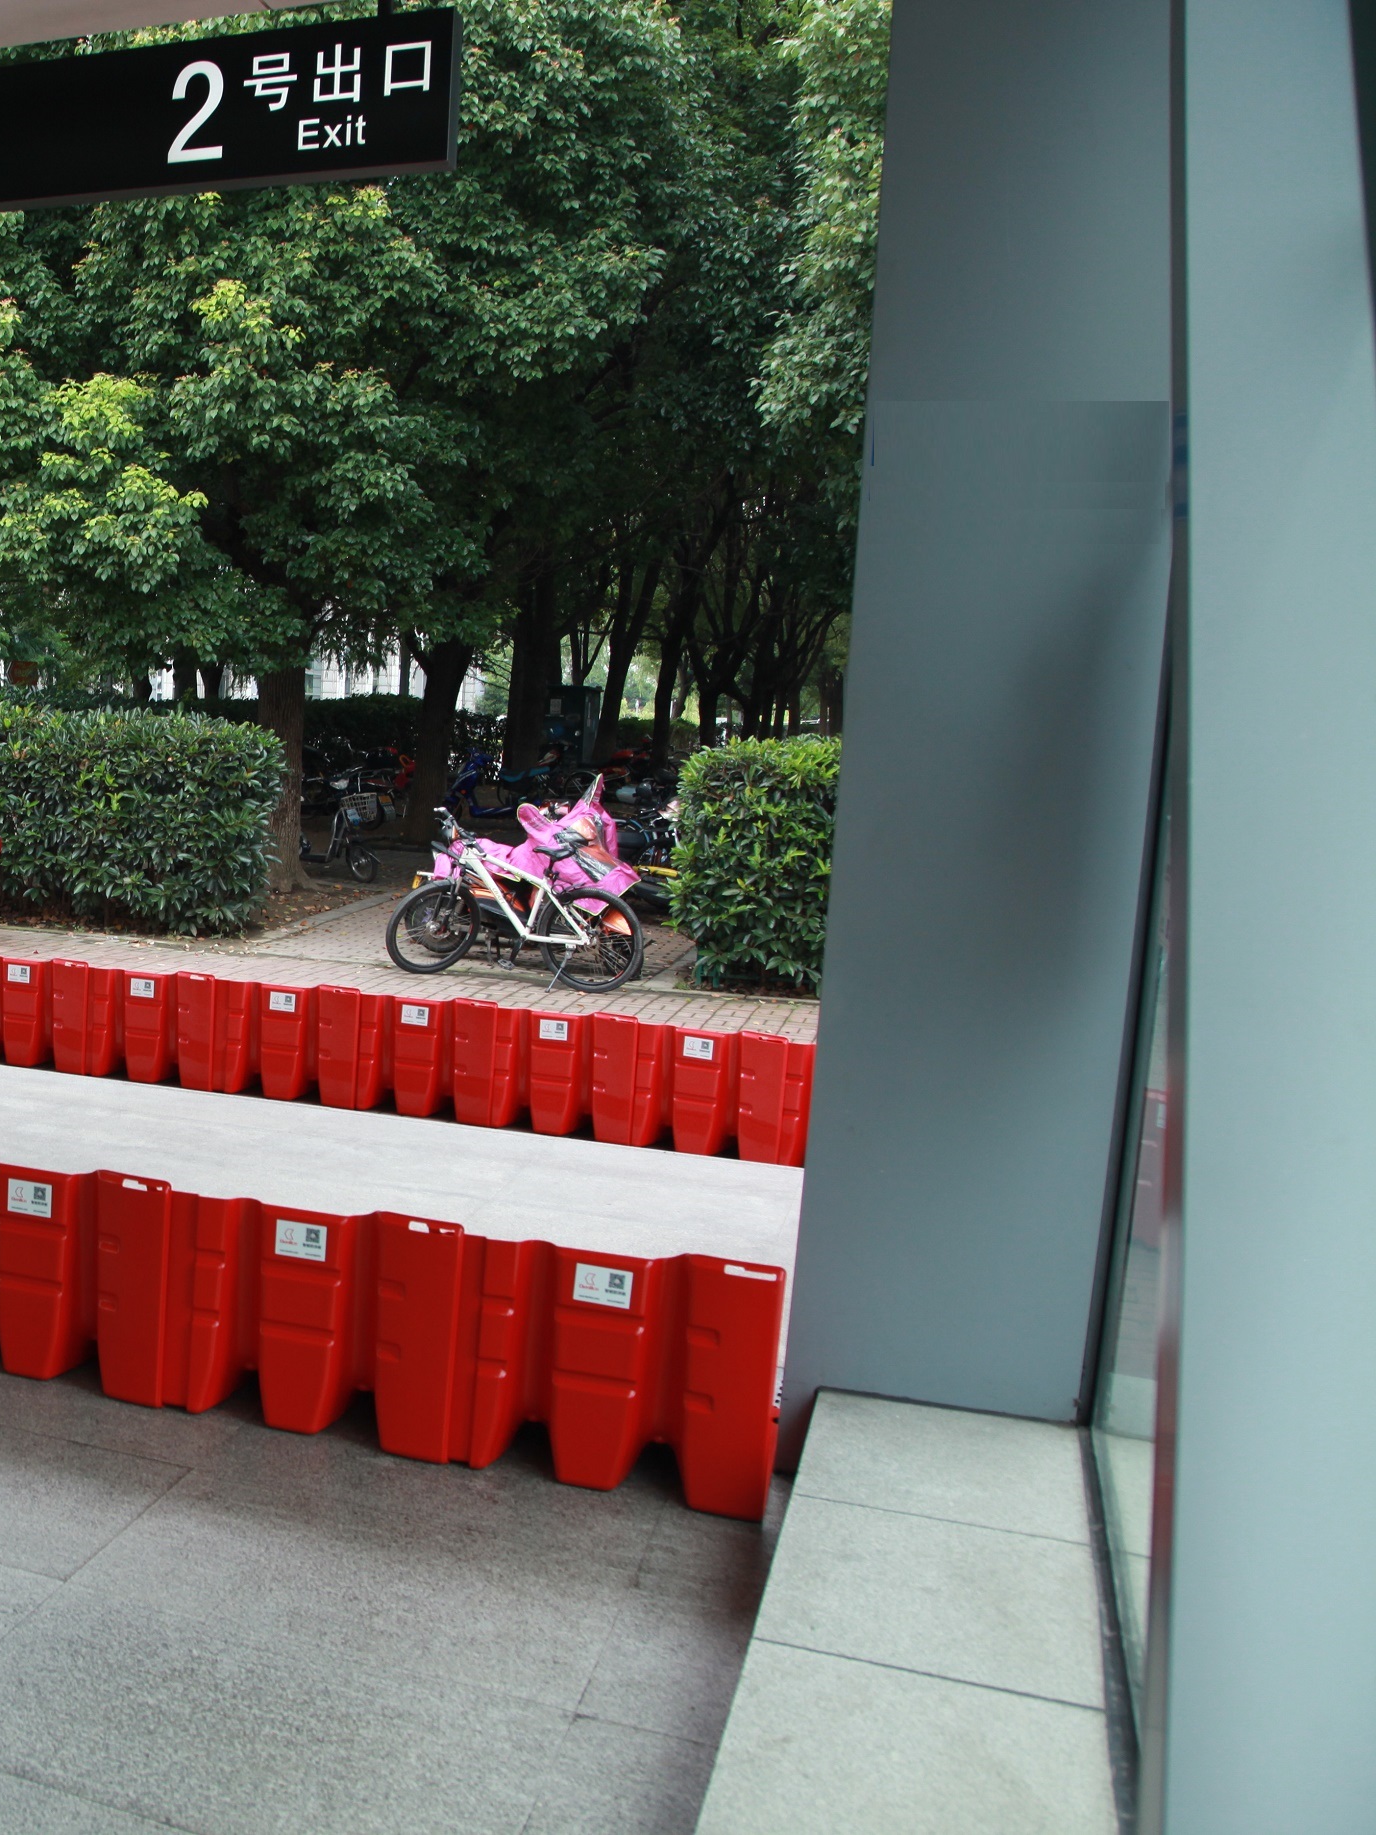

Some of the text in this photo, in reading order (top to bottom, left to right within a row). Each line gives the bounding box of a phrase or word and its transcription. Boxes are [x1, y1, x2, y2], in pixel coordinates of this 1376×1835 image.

[168, 40, 432, 163] 2 号出口
[298, 115, 367, 151] Exit
